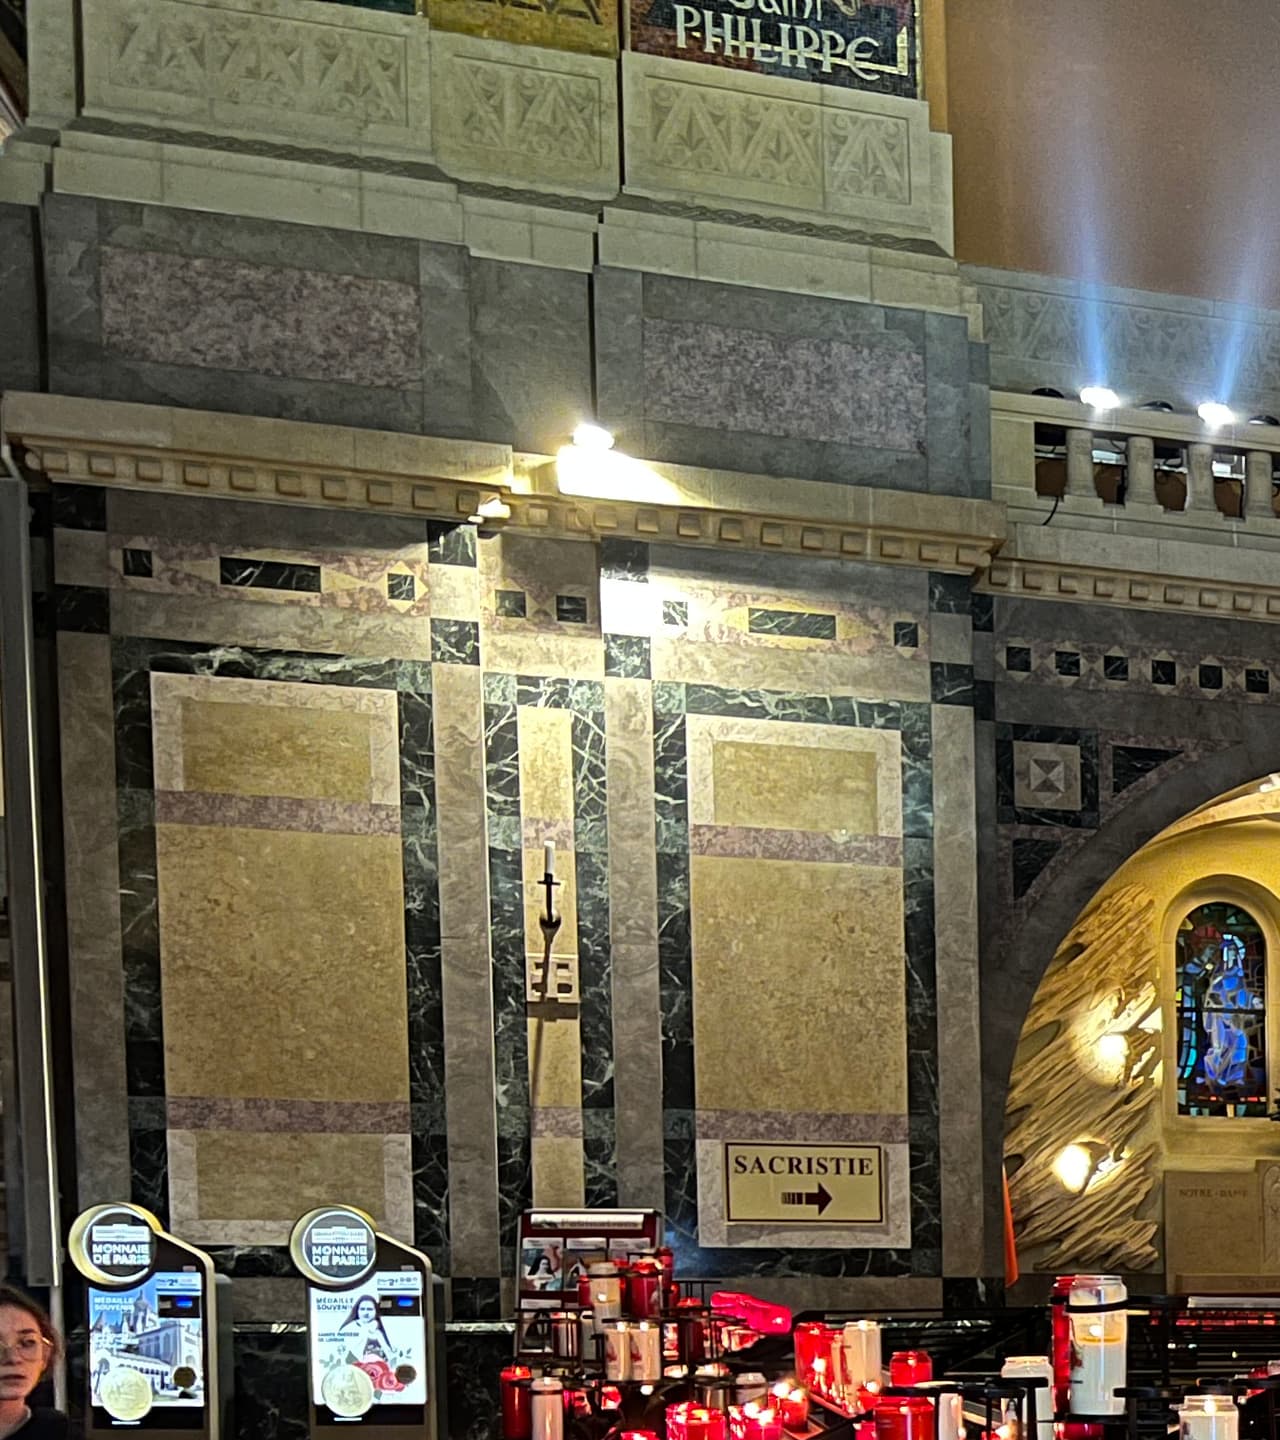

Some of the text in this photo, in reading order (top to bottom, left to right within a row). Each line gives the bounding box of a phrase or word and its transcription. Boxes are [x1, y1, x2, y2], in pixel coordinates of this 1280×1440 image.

[675, 4, 880, 80] PHILIPPE
[734, 1154, 874, 1176] SACRISTIE
[92, 1244, 149, 1254] MONNAIE
[311, 1245, 368, 1255] MONNAIE
[93, 1255, 151, 1265] DE PARIS
[312, 1255, 368, 1266] DE PARIS
